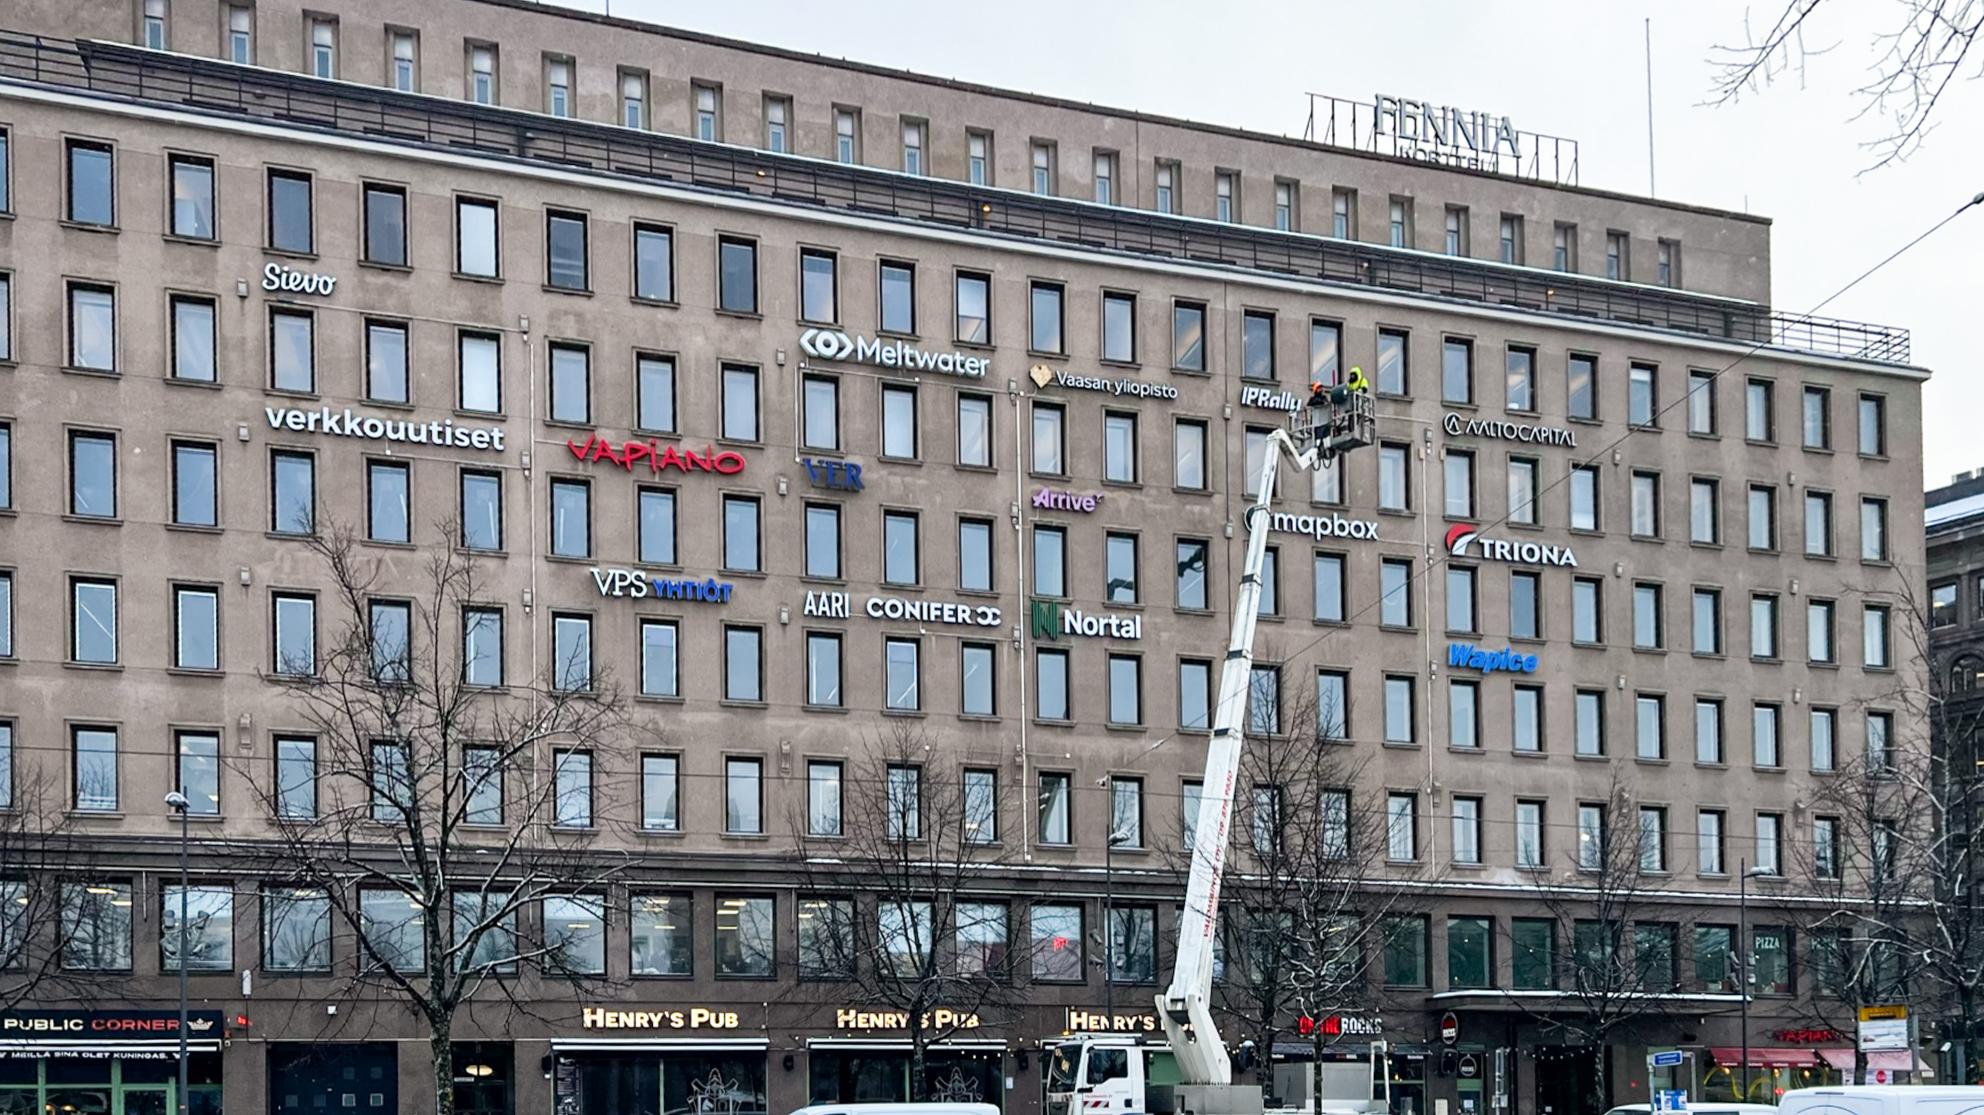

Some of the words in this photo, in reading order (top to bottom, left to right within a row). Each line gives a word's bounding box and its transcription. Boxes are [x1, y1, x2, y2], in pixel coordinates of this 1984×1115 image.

[1375, 93, 1521, 158] FENNIA
[262, 262, 336, 295] Sievo
[857, 335, 991, 377] Meltwater
[1056, 370, 1111, 391] Vaasan
[1114, 378, 1178, 400] yliopisto
[1241, 386, 1302, 412] IPRally
[265, 407, 505, 451] verkkouutiset
[802, 457, 864, 491] VER
[1032, 488, 1096, 513] Arrive
[1273, 512, 1379, 540] mapbox
[1479, 538, 1578, 567] TRIONA
[590, 567, 647, 598] VPS
[804, 590, 849, 619] AARI
[866, 597, 972, 625] CONIFER
[1063, 609, 1141, 639] Nortal
[1448, 643, 1539, 673] Wapice
[1755, 937, 1780, 949] PIZZA
[4, 1018, 84, 1031] PUBLIC
[91, 1018, 180, 1031] CORNER
[583, 1008, 685, 1029] HENRY'S
[690, 1008, 739, 1029] PUB
[836, 1009, 931, 1029] HENRYS
[1341, 1017, 1383, 1034] ROCKS
